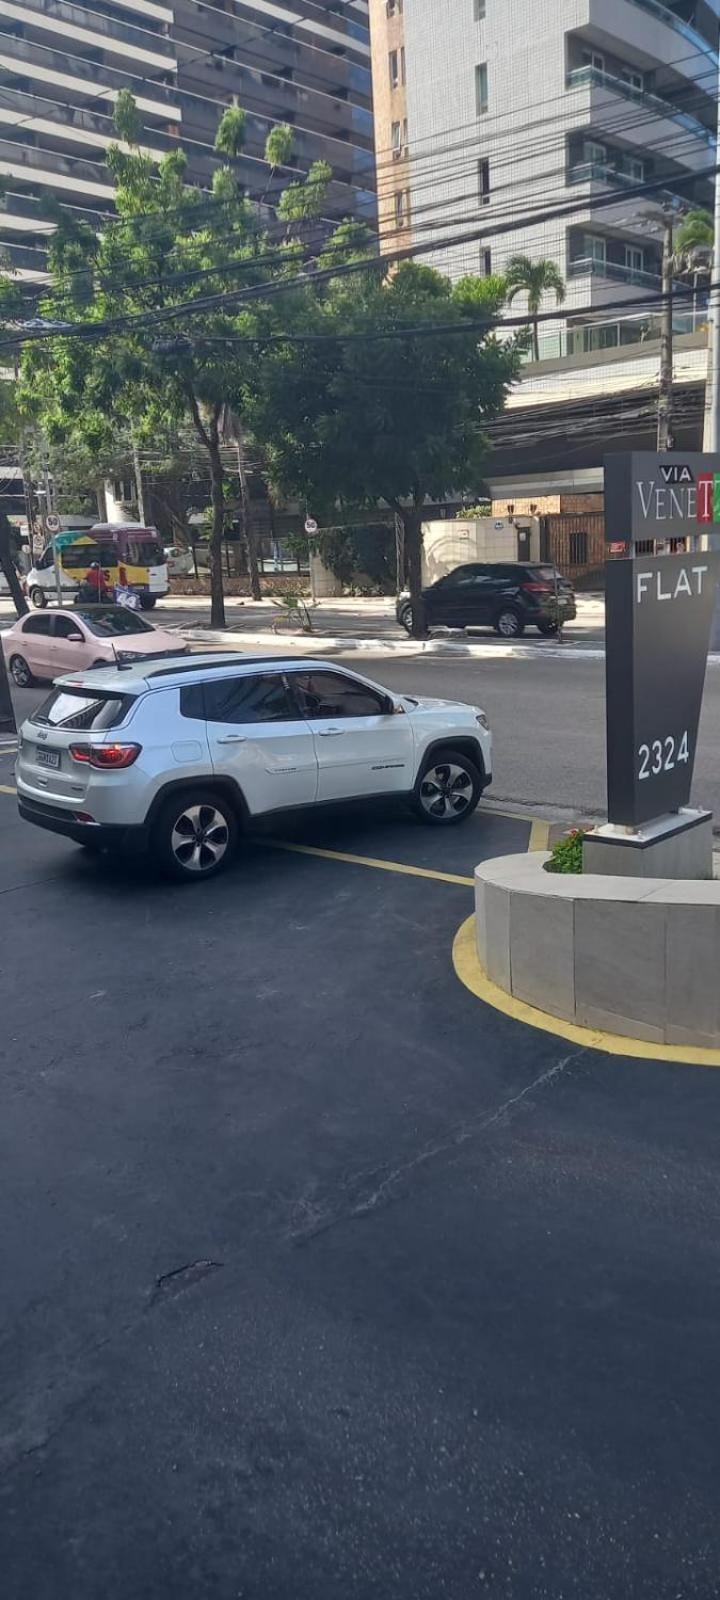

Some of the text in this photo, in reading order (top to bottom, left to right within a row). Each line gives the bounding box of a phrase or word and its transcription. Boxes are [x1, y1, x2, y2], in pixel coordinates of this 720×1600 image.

[660, 466, 692, 482] VIA
[637, 565, 708, 603] FLAT
[638, 729, 689, 780] 2324
